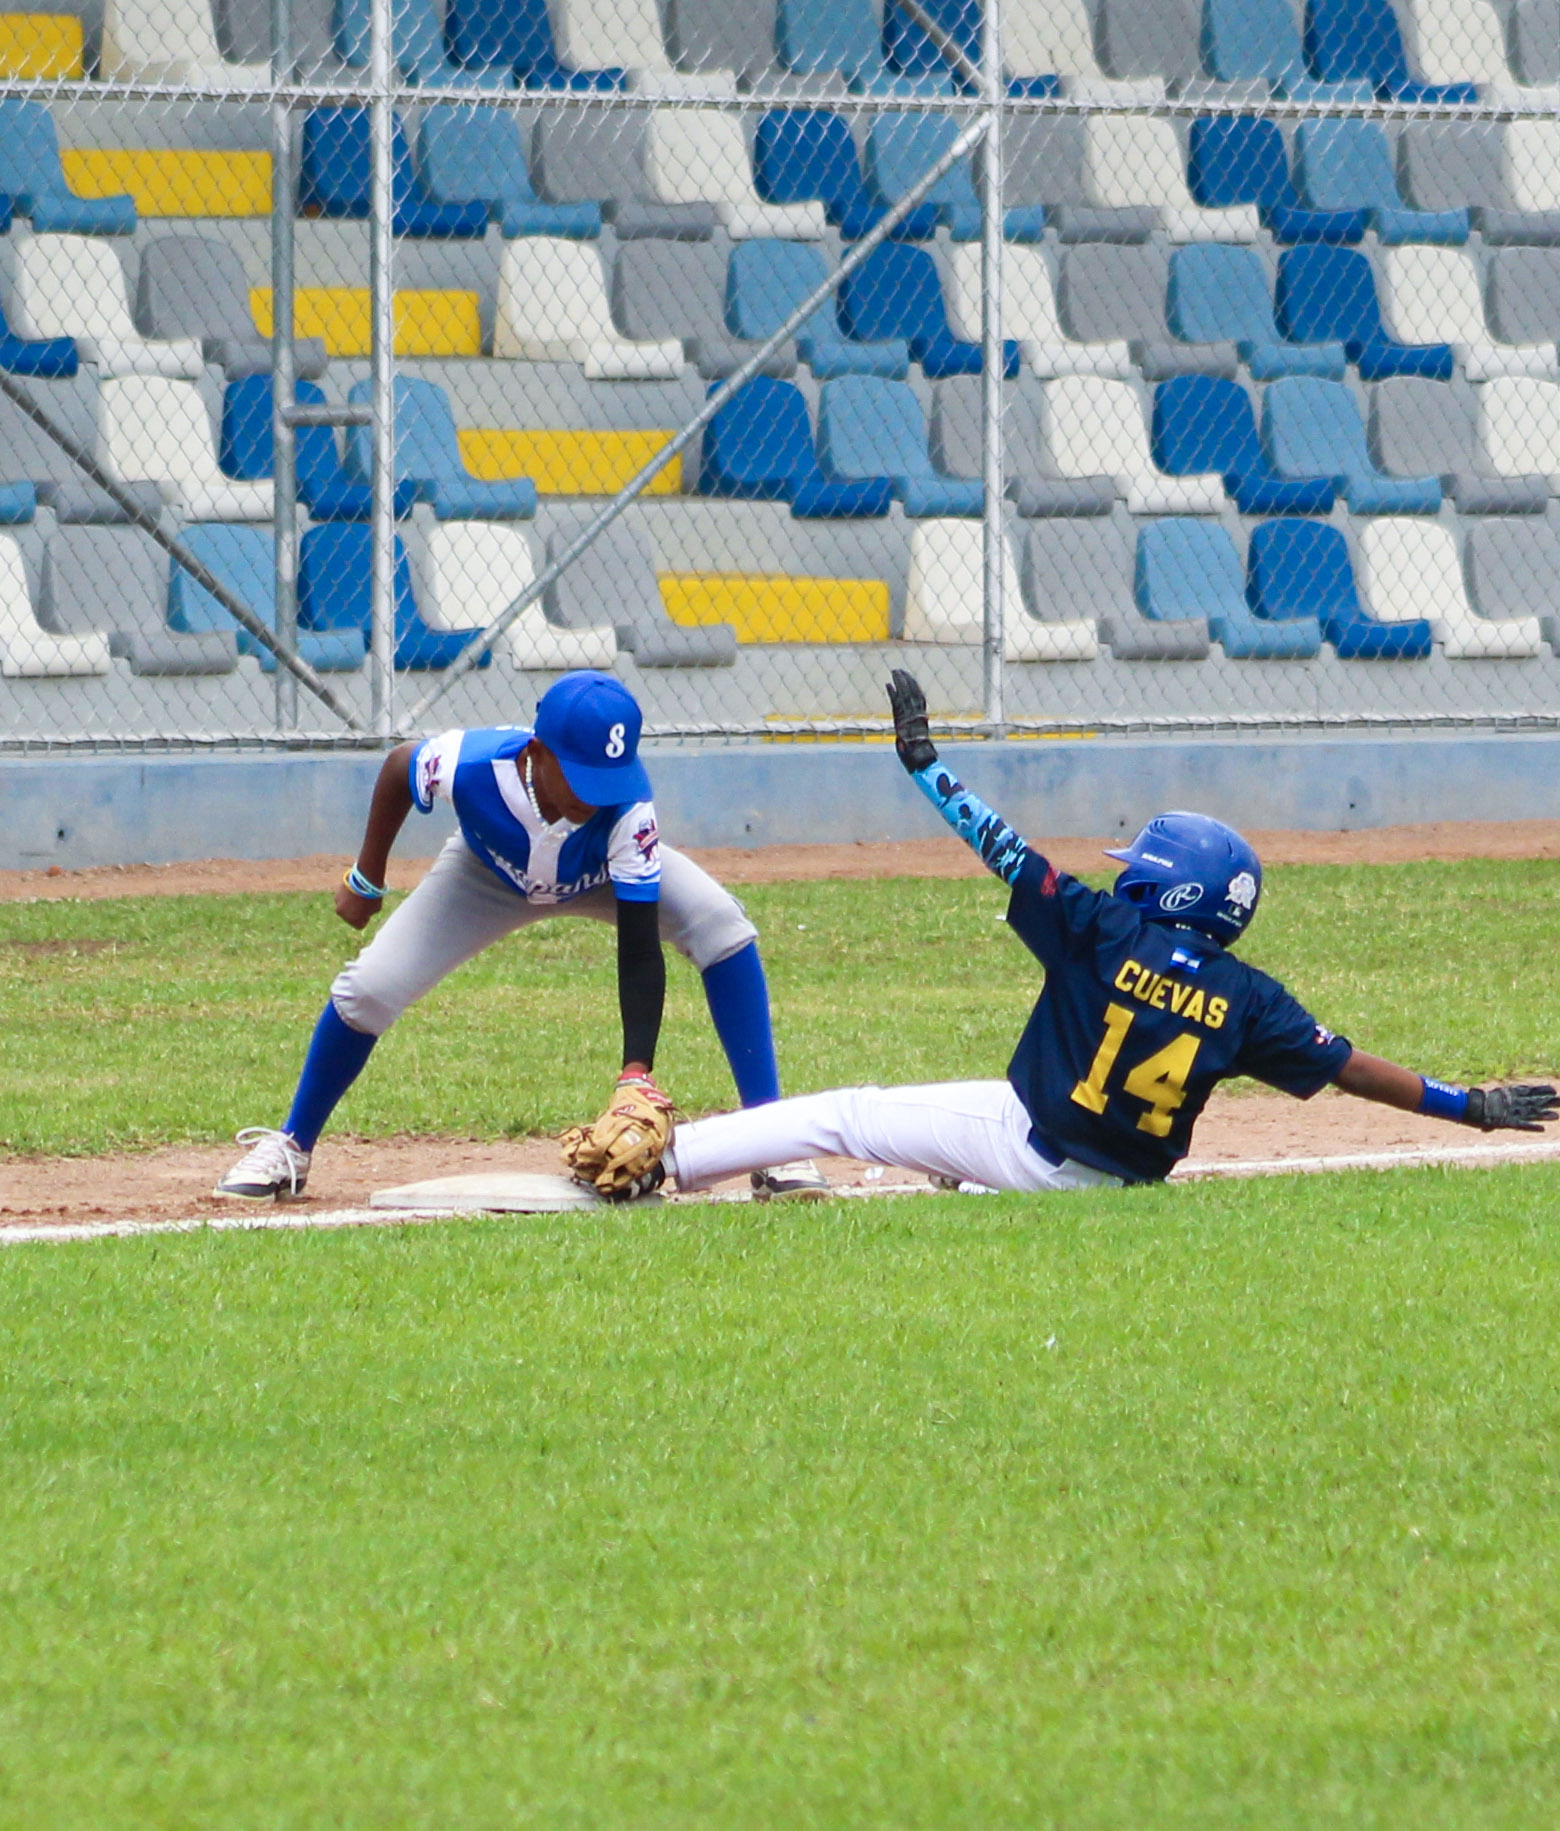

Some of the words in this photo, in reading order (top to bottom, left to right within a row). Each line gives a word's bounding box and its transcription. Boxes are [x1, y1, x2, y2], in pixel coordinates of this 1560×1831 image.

[605, 723, 626, 758] S
[1114, 959, 1229, 1031] CUEVAS
[1070, 1002, 1201, 1138] 14
